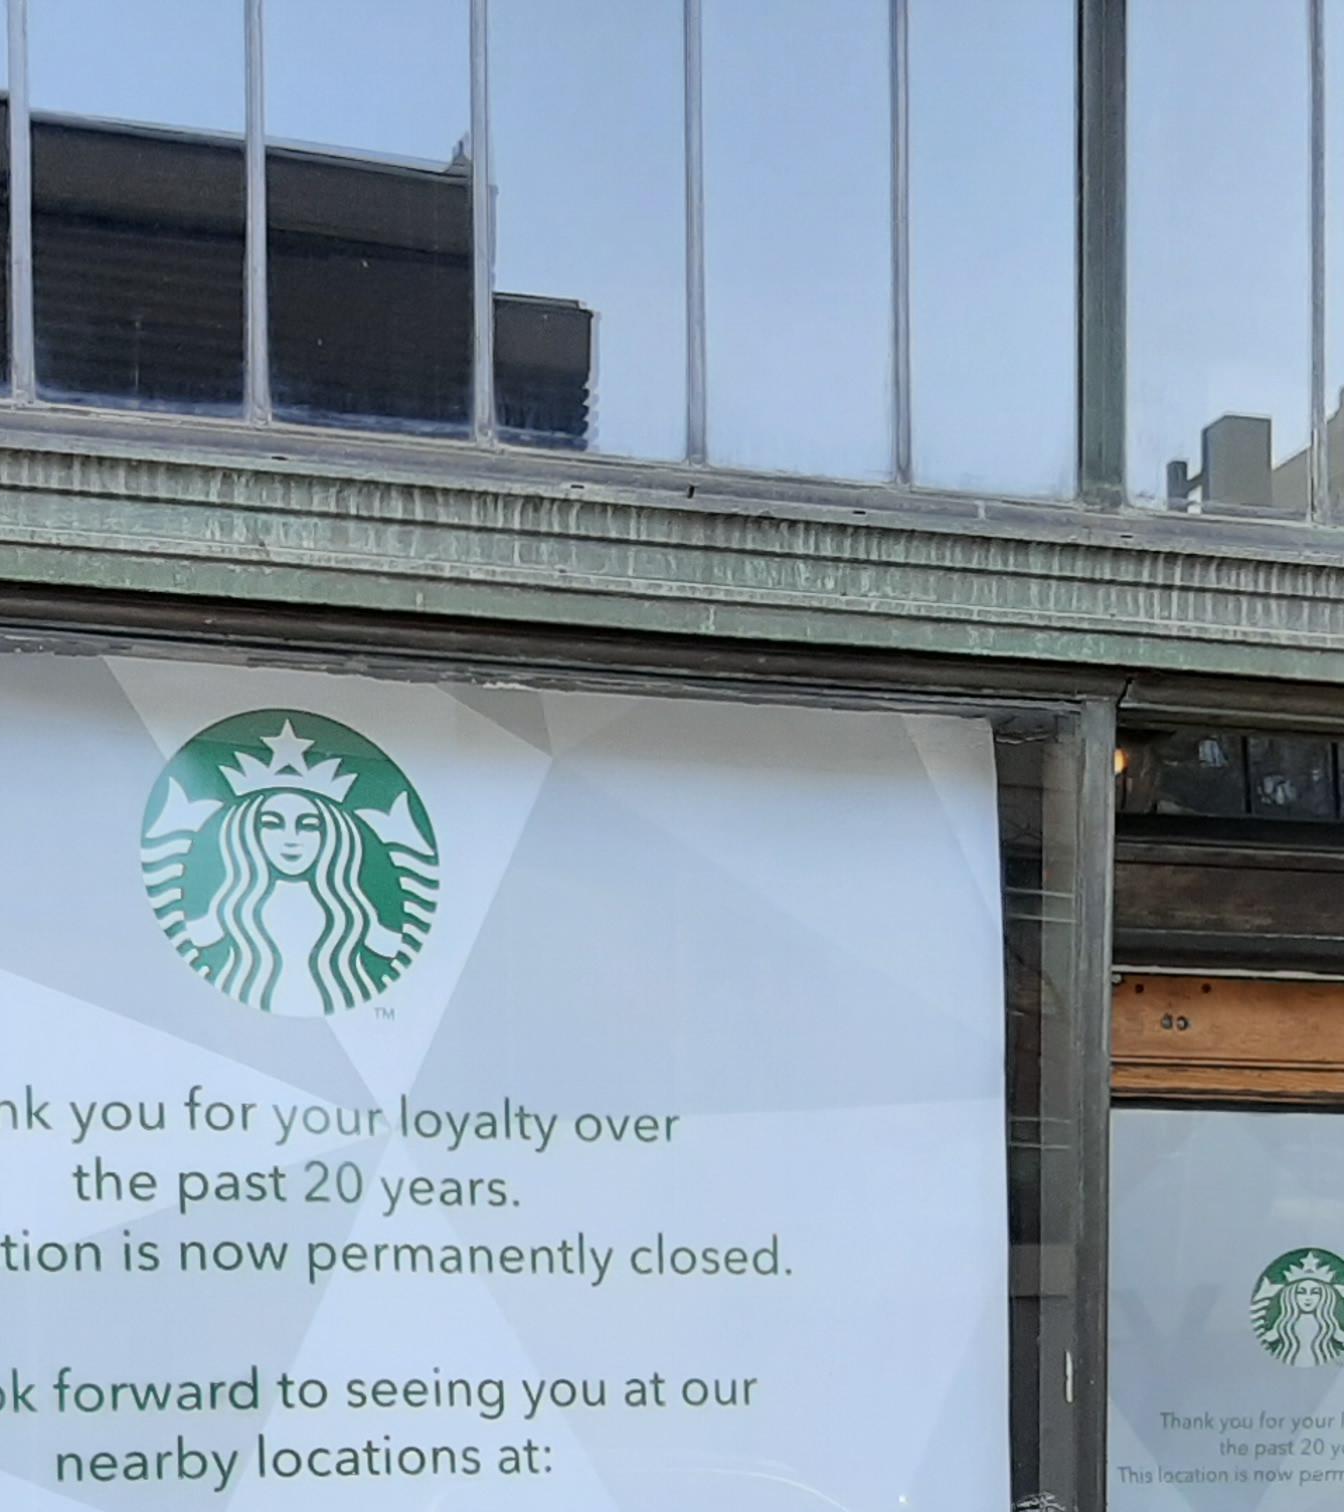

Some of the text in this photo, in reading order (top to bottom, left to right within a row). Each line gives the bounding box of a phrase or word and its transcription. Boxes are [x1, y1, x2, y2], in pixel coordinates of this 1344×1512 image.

[70, 1102, 164, 1144] you
[184, 1085, 255, 1130] for
[272, 1105, 383, 1146] your
[402, 1094, 557, 1153] loyalty
[575, 1114, 678, 1142] over
[73, 1157, 519, 1216] the past 20 years.
[124, 1230, 159, 1271] is
[181, 1242, 288, 1270] now
[308, 1232, 612, 1286] permanently
[631, 1233, 791, 1275] closed.
[53, 1365, 258, 1412] forward
[277, 1373, 327, 1408] to
[347, 1368, 504, 1419] seeing
[522, 1379, 605, 1419] you
[625, 1373, 664, 1406] at
[682, 1379, 756, 1406] our
[1160, 1412, 1214, 1430] Thank
[1219, 1416, 1253, 1434] you
[1259, 1412, 1286, 1430] for
[1292, 1416, 1335, 1433] your
[1220, 1438, 1249, 1456] the
[1255, 1441, 1294, 1460] past
[1300, 1439, 1325, 1456] 20
[57, 1434, 551, 1492] nearby locations at:
[1117, 1466, 1152, 1484] This
[1158, 1466, 1228, 1484] location
[1235, 1466, 1248, 1482] is
[1254, 1470, 1293, 1482] now
